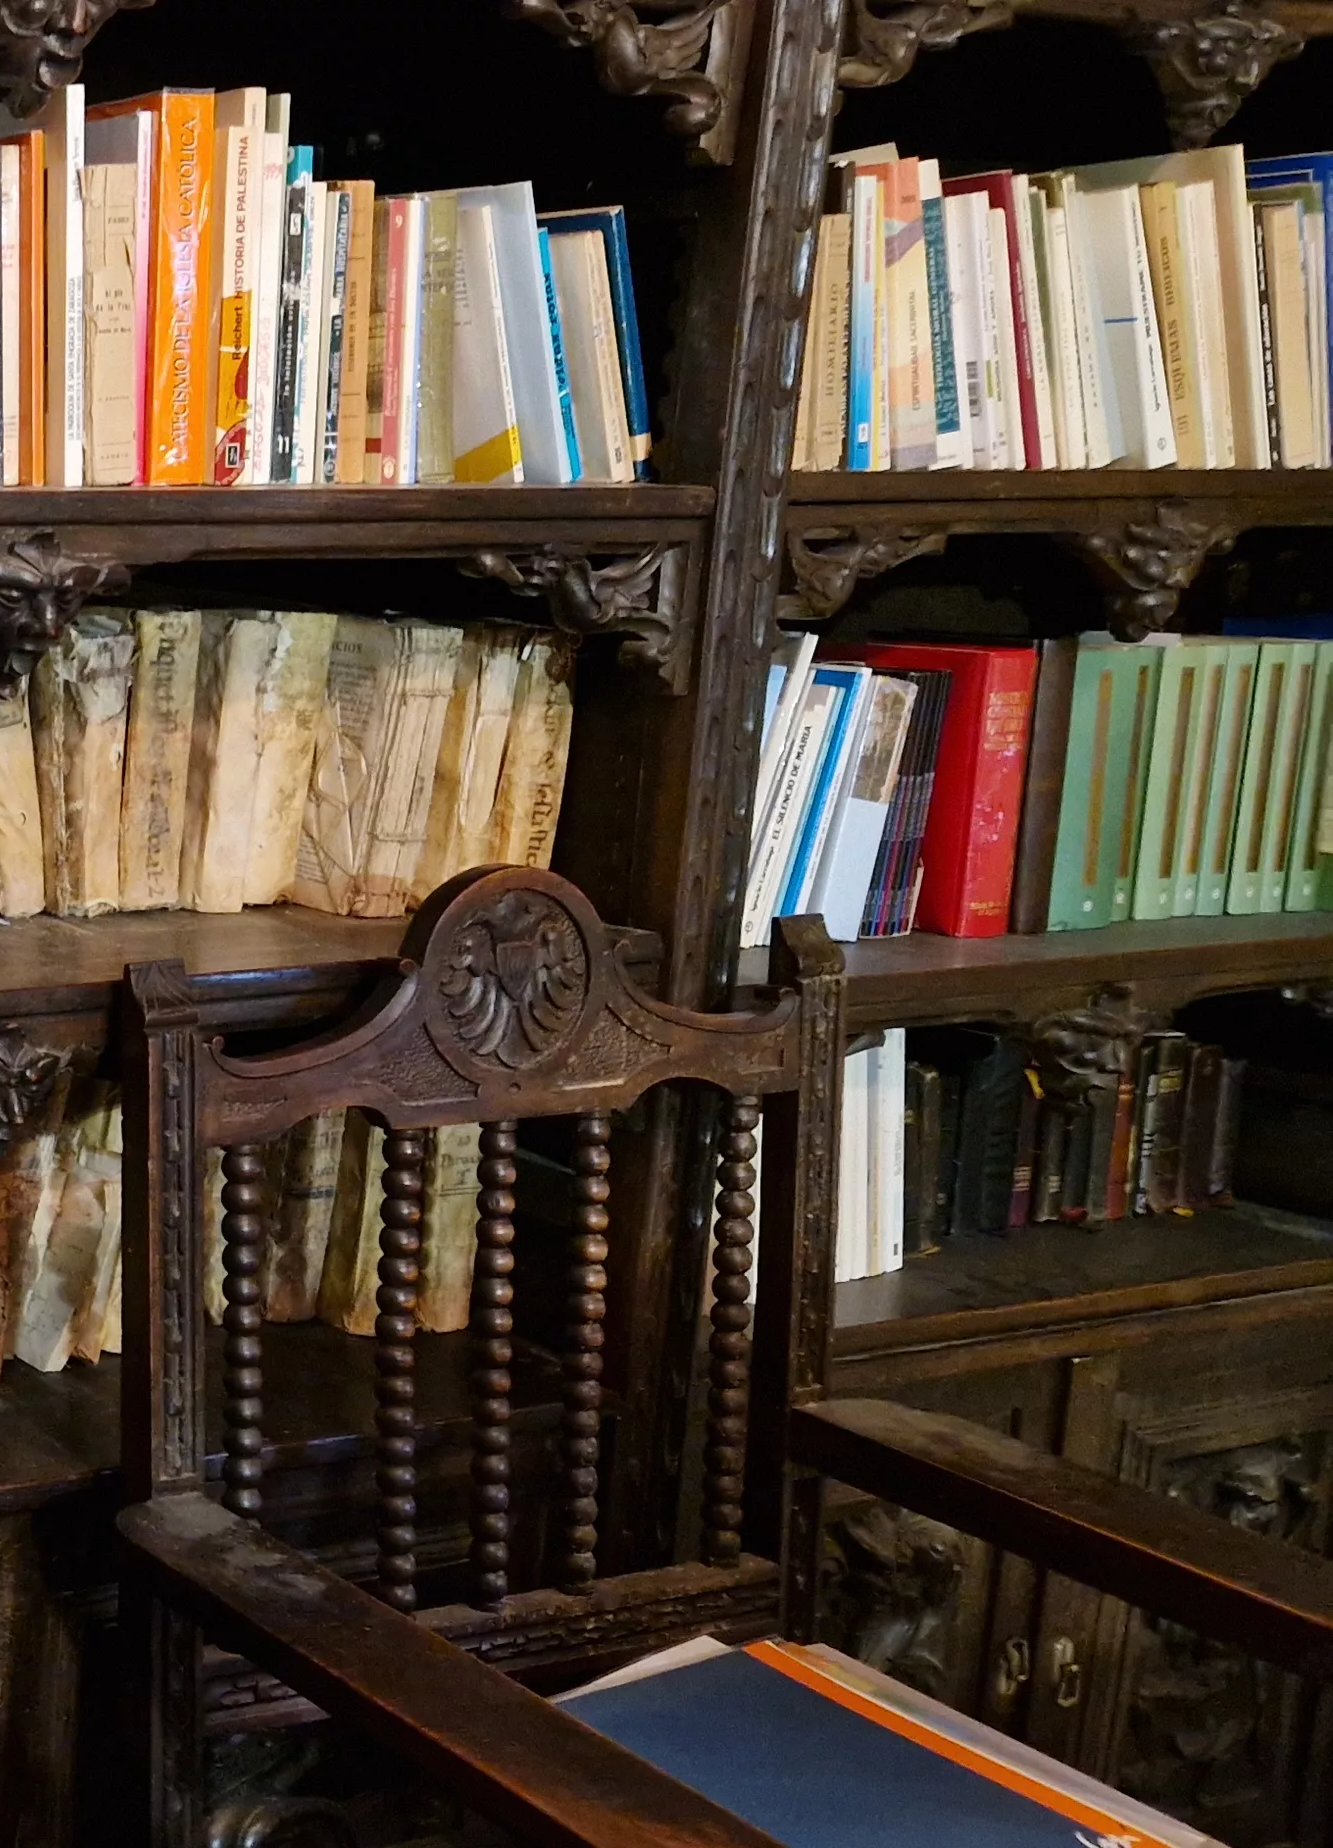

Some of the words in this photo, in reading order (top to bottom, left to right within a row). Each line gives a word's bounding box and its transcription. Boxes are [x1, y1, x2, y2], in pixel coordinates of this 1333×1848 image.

[178, 119, 195, 220] CATÓLICA
[236, 136, 249, 212] PALESTINA
[236, 214, 246, 233] DE
[175, 226, 193, 294] IGLESIA
[235, 236, 246, 299] HISTORIA
[1159, 237, 1174, 305] BIBLICOS
[174, 300, 191, 327] LA
[174, 331, 191, 352] DE
[232, 306, 243, 361] Reichert
[825, 283, 838, 396] HOMILIARIO
[1167, 320, 1185, 400] ESQUEMAS
[172, 358, 191, 461] CATECISMO
[773, 828, 781, 840] EL
[777, 779, 795, 825] SILENCIO
[790, 764, 799, 776] DE
[795, 725, 811, 761] MARIA
